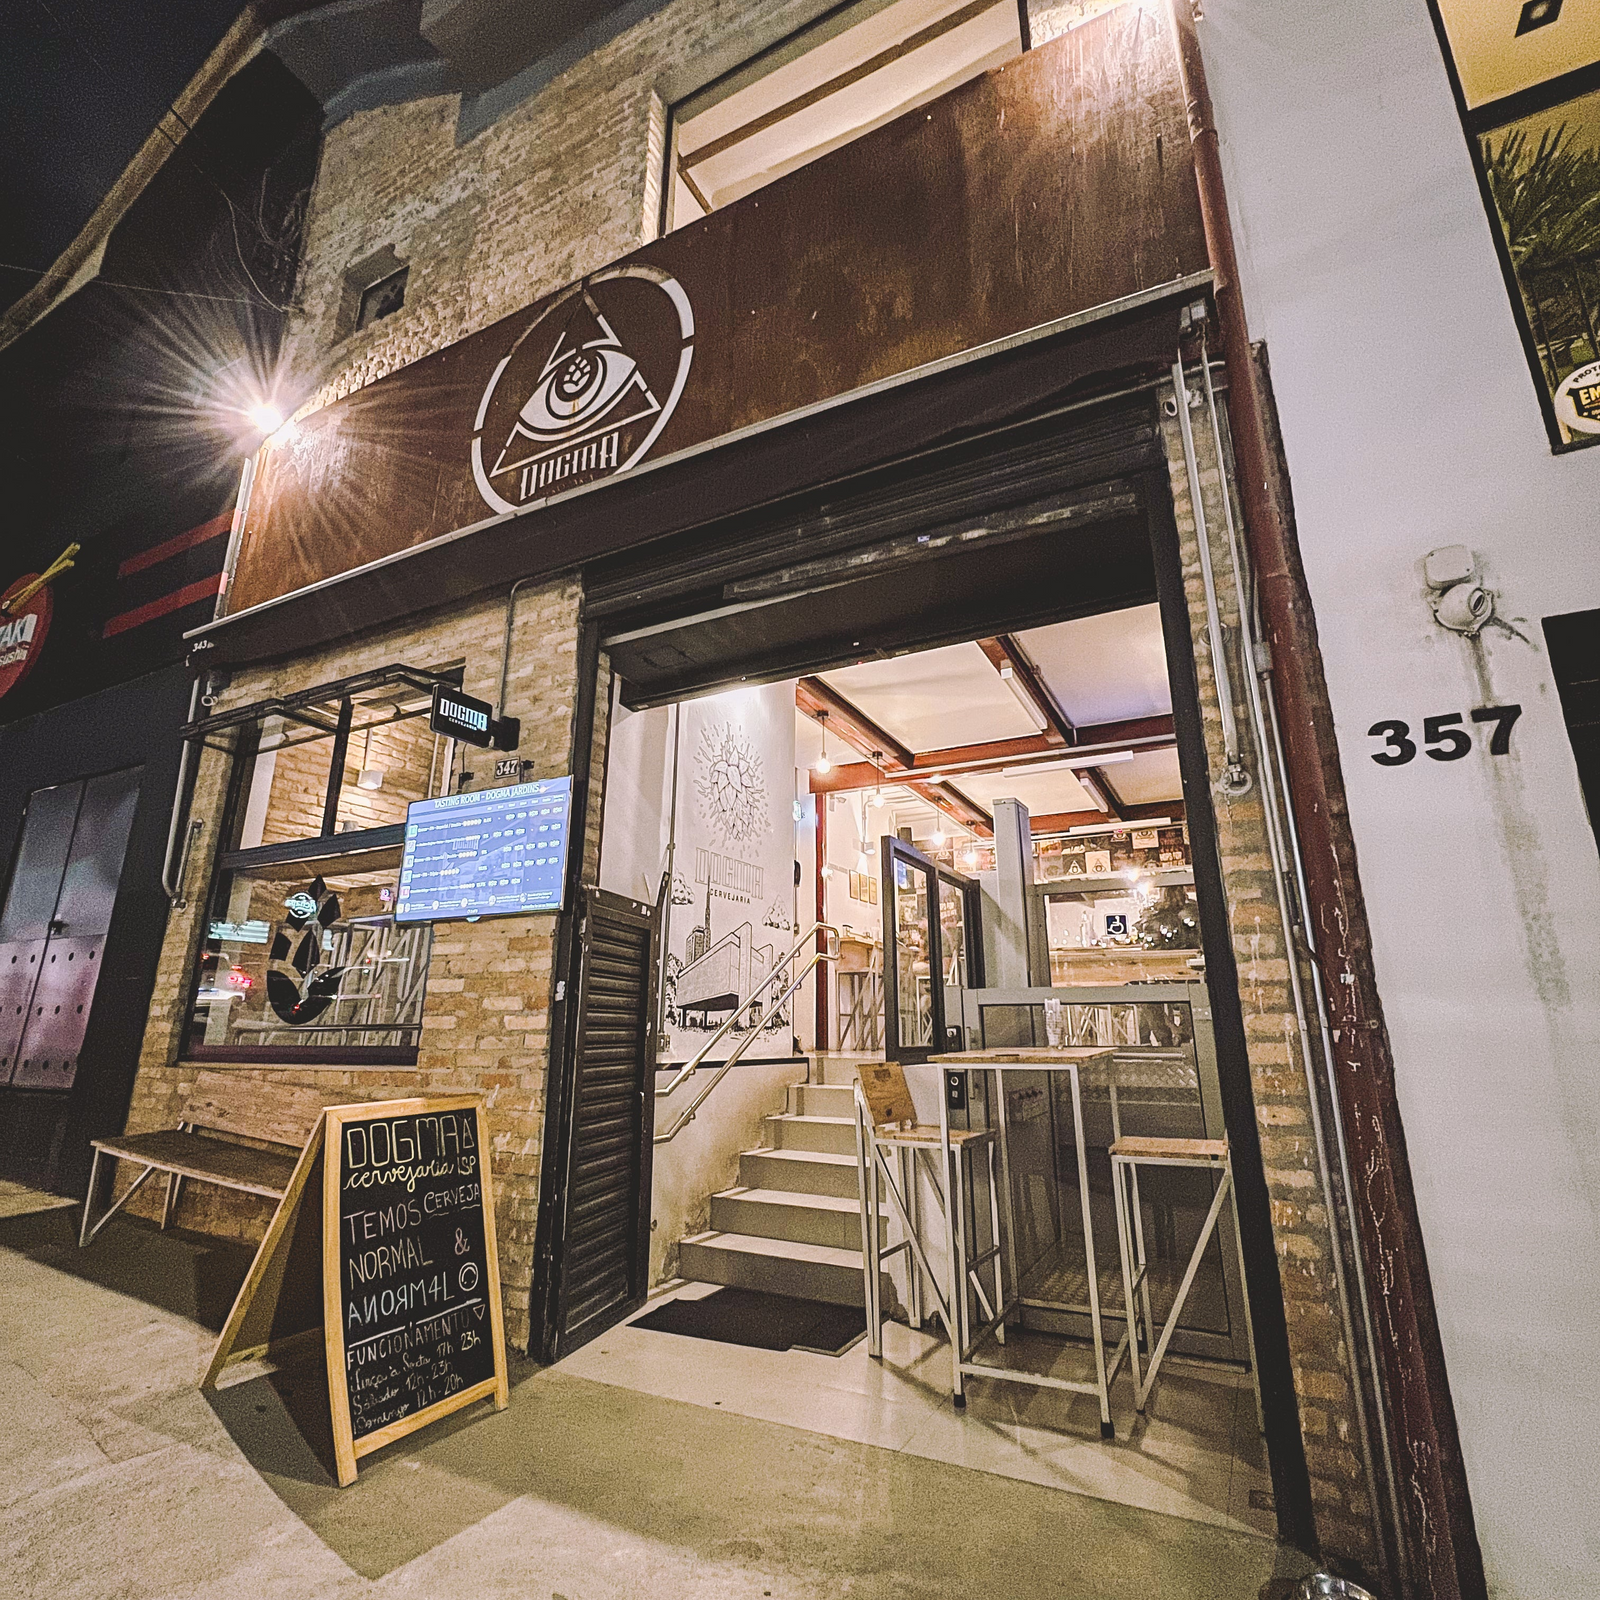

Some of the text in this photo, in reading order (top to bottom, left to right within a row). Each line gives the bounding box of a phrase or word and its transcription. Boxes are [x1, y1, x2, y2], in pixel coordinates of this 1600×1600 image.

[1579, 385, 1600, 406] EM
[520, 431, 619, 501] DOGMA
[439, 698, 488, 732] DOGMA
[1367, 704, 1522, 766] 357
[496, 760, 518, 776] 347
[434, 796, 460, 808] TASTING
[460, 793, 480, 806] ROOM
[485, 790, 511, 800] DOGMA
[510, 783, 540, 797] JARDINS
[694, 847, 764, 900] DOGMA
[709, 888, 751, 905] CERVEJARIA
[346, 1115, 459, 1168] DOGMA
[343, 1159, 455, 1192] cervejaria
[343, 1182, 480, 1245] TEMOS CERVEJA
[349, 1227, 471, 1290] NORMAL &
[347, 1307, 470, 1370] FUNCIONAMENTO
[460, 1330, 481, 1351] 23h
[405, 1372, 425, 1391] 12h
[431, 1359, 453, 1380] 23h
[416, 1385, 437, 1408] 12h
[444, 1375, 464, 1396] 20h
